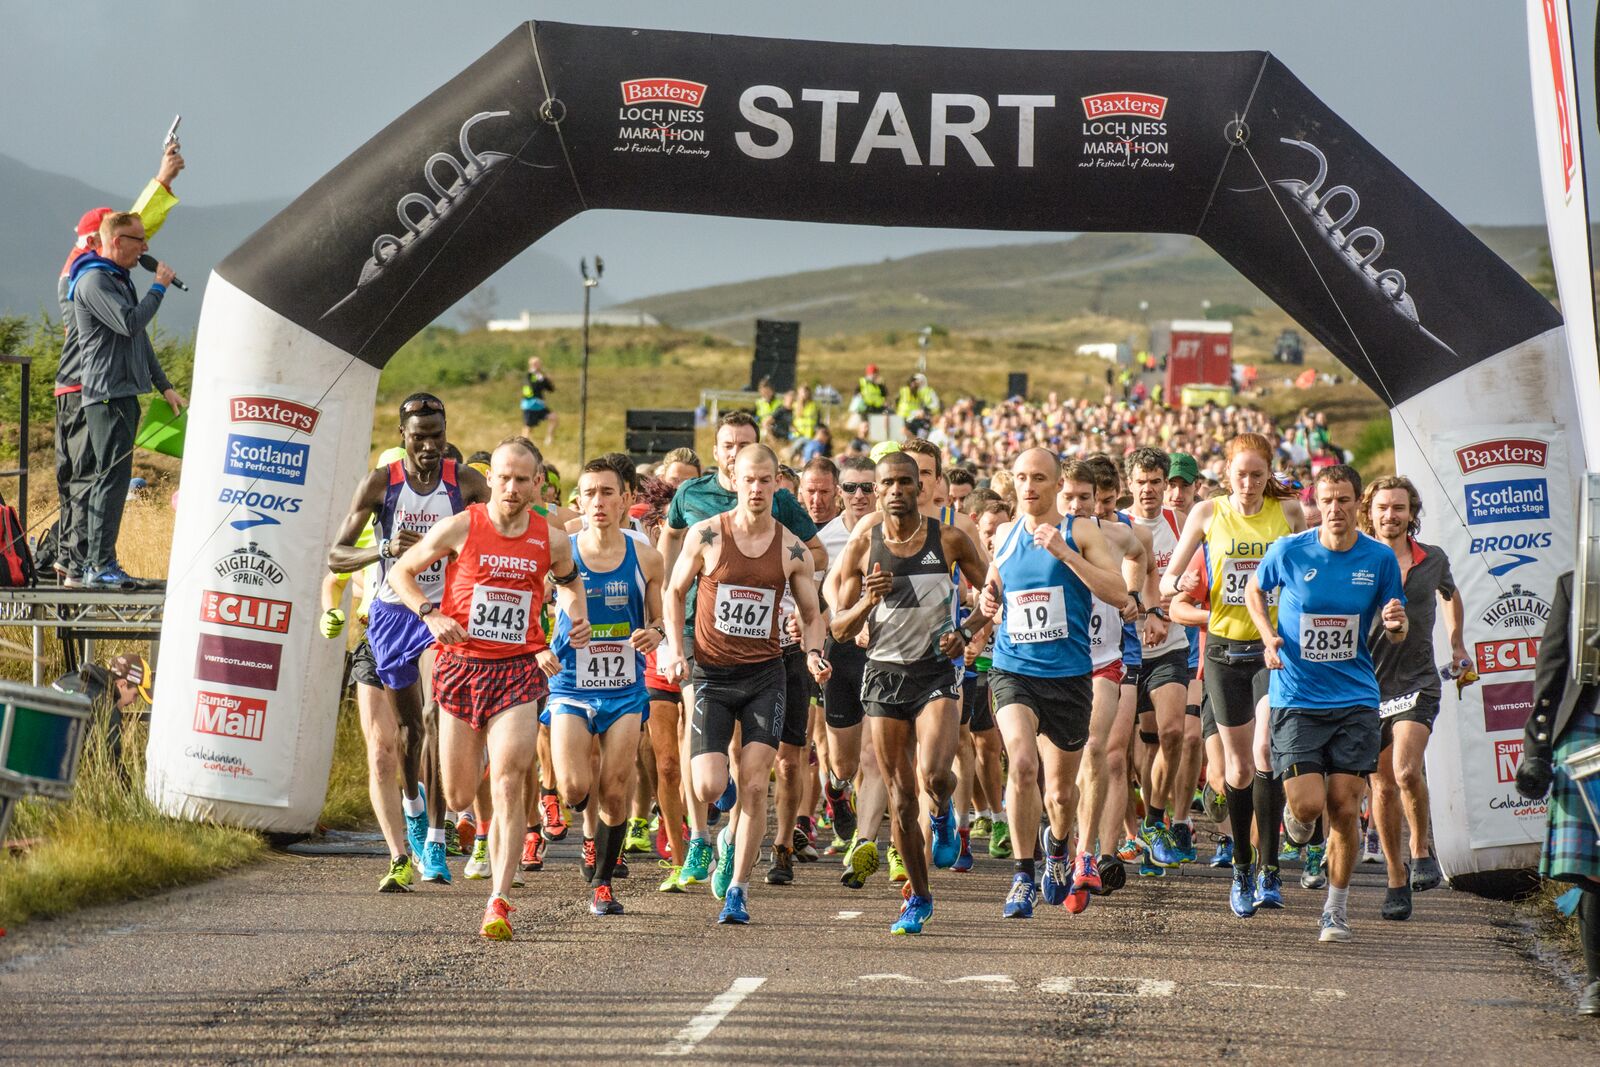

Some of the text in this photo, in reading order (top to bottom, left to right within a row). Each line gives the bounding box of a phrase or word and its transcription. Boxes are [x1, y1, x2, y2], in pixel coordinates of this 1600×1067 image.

[628, 83, 699, 102] Baxters
[1089, 97, 1160, 114] Baxters
[619, 108, 704, 123] LOCH NESS
[619, 126, 705, 142] MARATHON
[734, 85, 1056, 167] START
[1082, 122, 1168, 135] LOCH NESS
[613, 143, 710, 158] and Festival of Running
[1083, 140, 1169, 155] MARATHON
[1078, 158, 1175, 171] and Festival of Running
[234, 400, 313, 429] Baxters
[231, 441, 304, 467] Scotland
[1462, 444, 1543, 469] Baxters
[230, 459, 301, 478] The Perfect Stage
[218, 487, 303, 513] BROOKS
[1471, 484, 1544, 507] Scotland
[397, 509, 439, 525] Taylor
[1472, 503, 1544, 517] The Perfect Stage
[1469, 532, 1552, 554] BROOKS
[214, 556, 284, 585] HIGHLAND
[479, 554, 538, 573] FORRES
[233, 573, 264, 586] SPRING
[418, 574, 440, 582] NESS
[489, 566, 526, 580] Harriers
[488, 591, 520, 604] Baxters
[731, 590, 763, 601] Baxters
[1017, 593, 1049, 603] Baxters
[207, 594, 288, 628] BAR CLIF
[473, 603, 525, 631] 3443
[718, 601, 770, 626] 3467
[1023, 606, 1048, 629] 19
[719, 623, 766, 637] LOCH NESS
[1314, 619, 1346, 627] Baxters
[1504, 616, 1535, 628] SPRING
[472, 627, 522, 642] LOCH NESS
[1014, 629, 1064, 641] LOCH NESS
[1304, 629, 1354, 650] 2834
[591, 644, 621, 653] Baxters
[1305, 651, 1353, 660] LOCH NESS
[204, 654, 273, 670] VISITSCOTLAND.COM
[1484, 645, 1496, 669] BAR
[587, 656, 625, 677] 412
[582, 679, 632, 688] LOCH NESS
[199, 693, 241, 711] Sunday
[1394, 701, 1413, 711] NESS
[195, 704, 264, 738] Mail
[185, 745, 242, 765] Caledonian
[203, 762, 254, 779] concepts
[1514, 806, 1548, 816] conce
